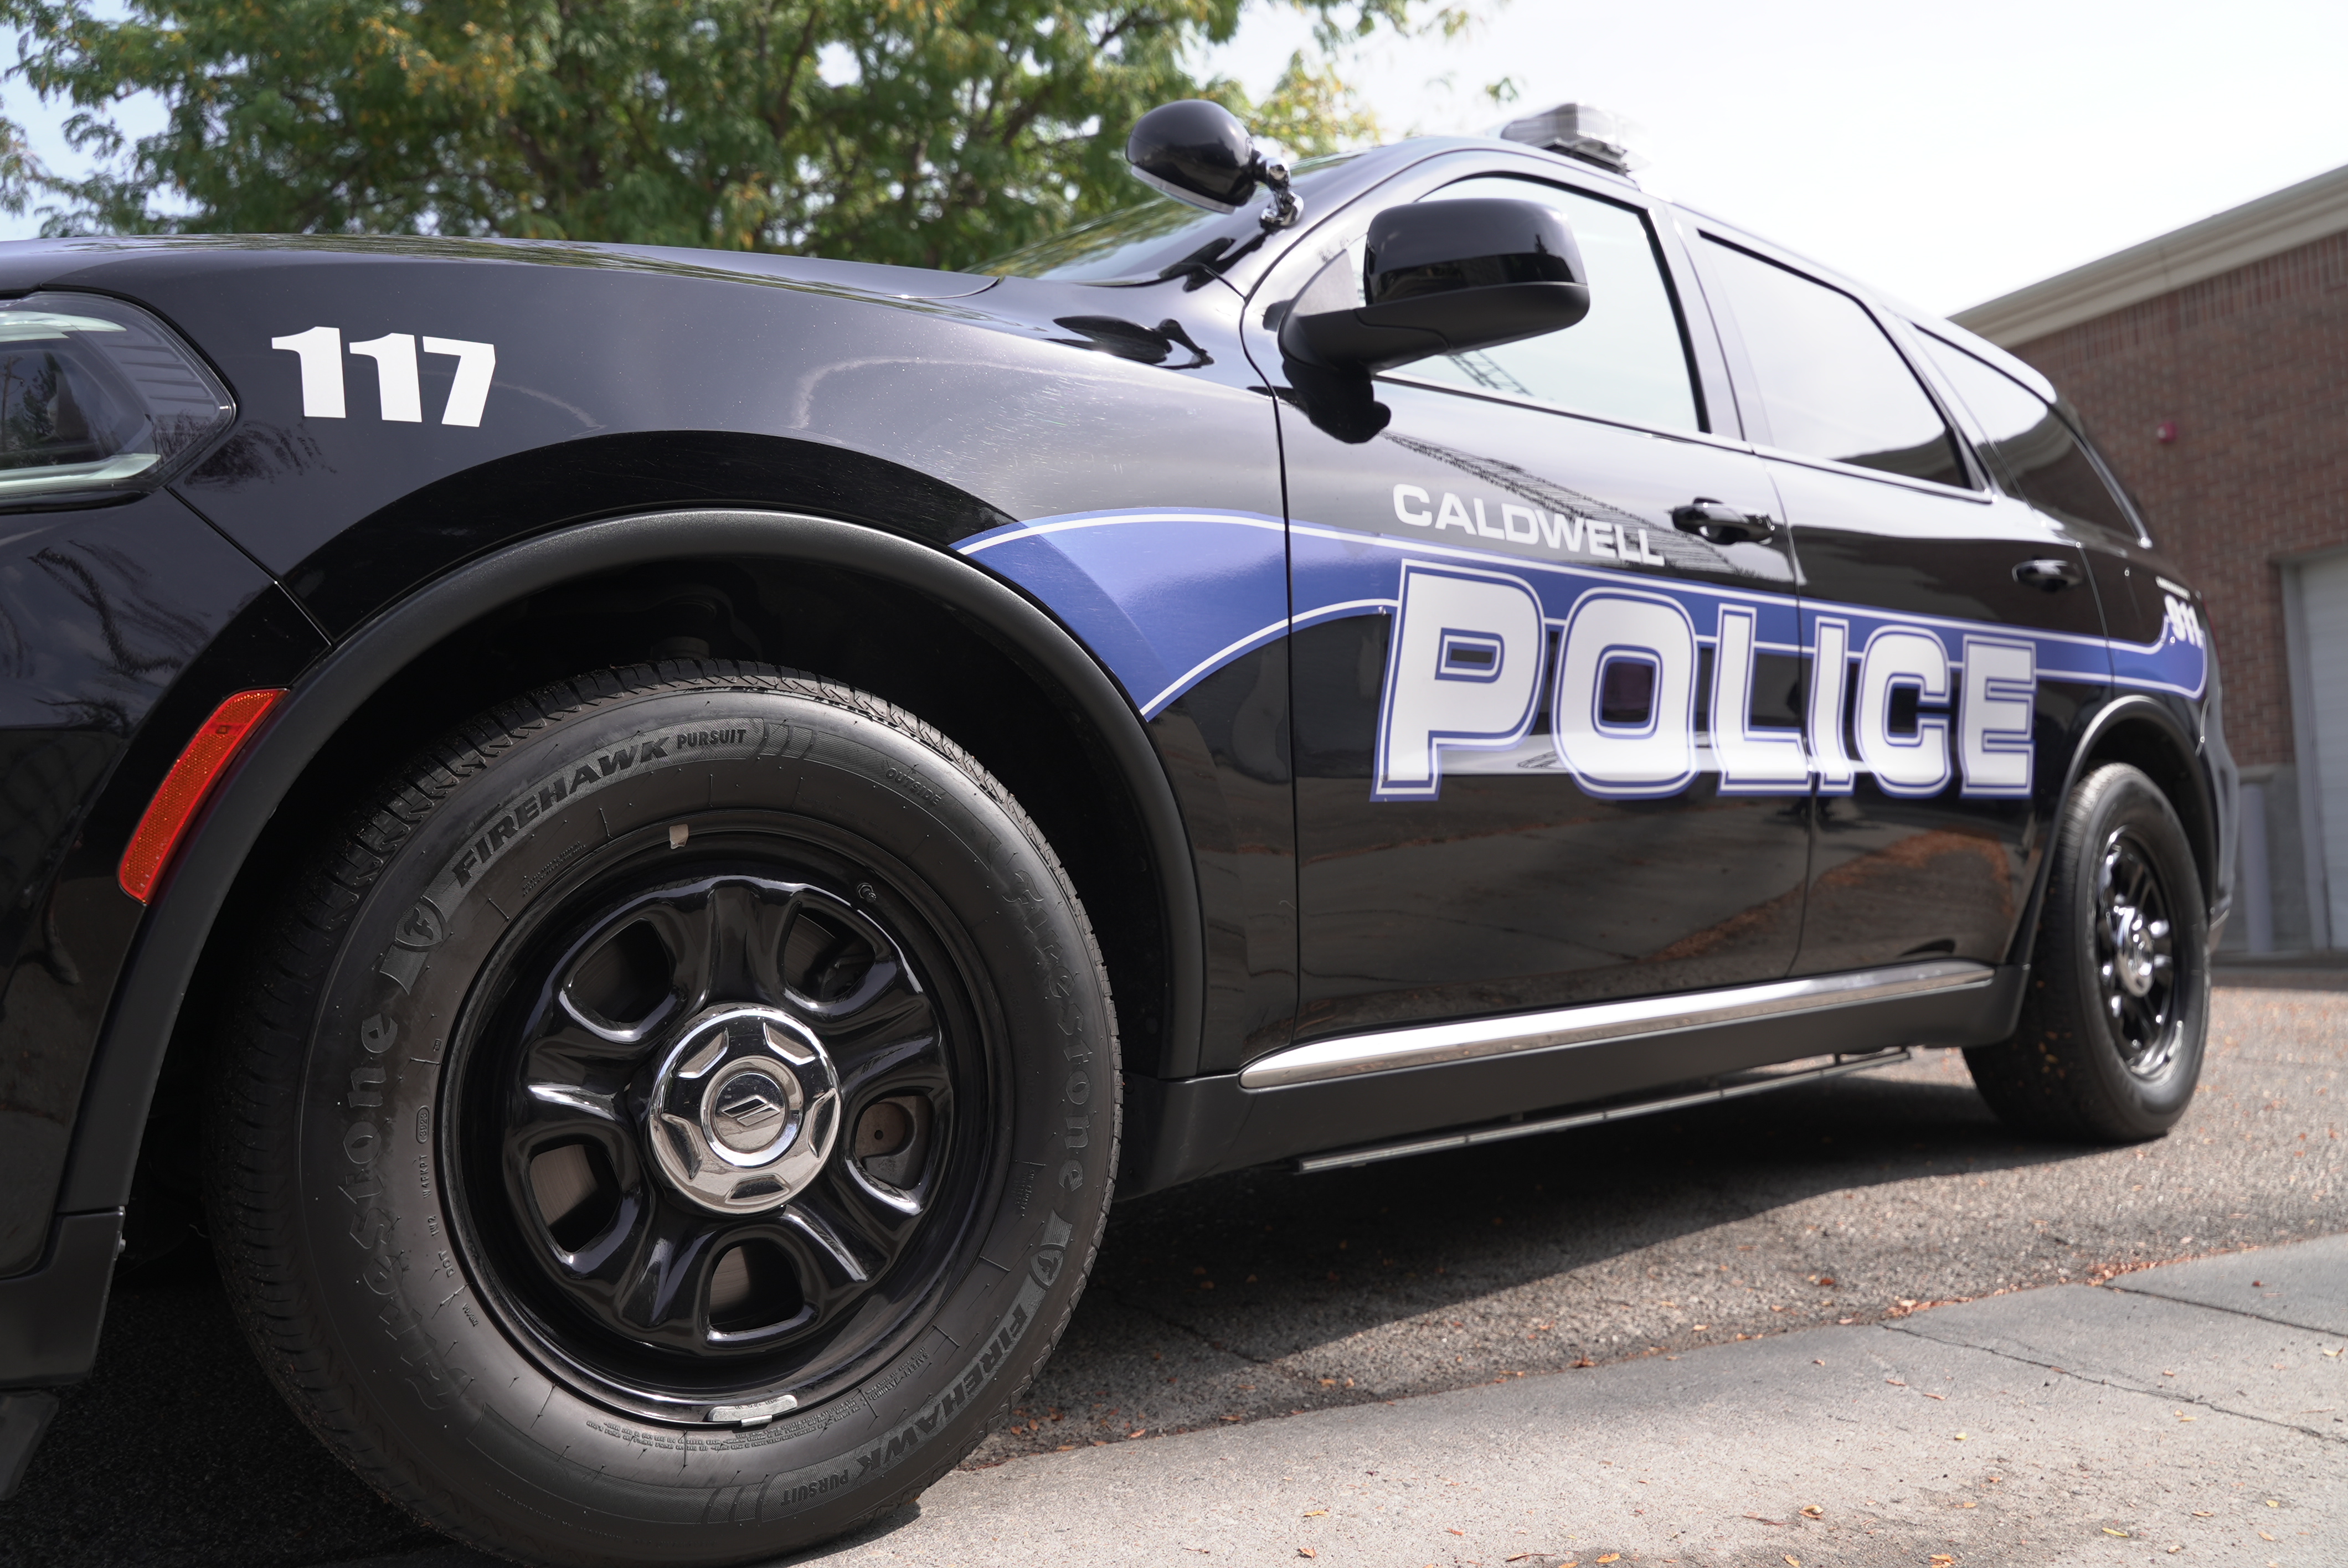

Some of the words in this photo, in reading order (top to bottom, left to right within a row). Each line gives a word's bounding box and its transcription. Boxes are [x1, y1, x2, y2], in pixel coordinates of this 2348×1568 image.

[271, 326, 496, 427] 117
[1393, 483, 1665, 566] CALDWELL
[1369, 558, 2037, 802] POLICE
[452, 735, 670, 888] FIREHAWK
[677, 728, 747, 750] PURSUIT
[887, 766, 943, 807] OUTSIDE
[1002, 869, 1093, 1192] Firestone
[419, 1112, 429, 1139] 3923
[338, 1012, 467, 1410] Firestone
[438, 1250, 455, 1278] DOT
[856, 1304, 1028, 1481] FIREHAWK
[903, 1352, 930, 1377] SAFETY
[781, 1468, 849, 1507] PURSUIT
